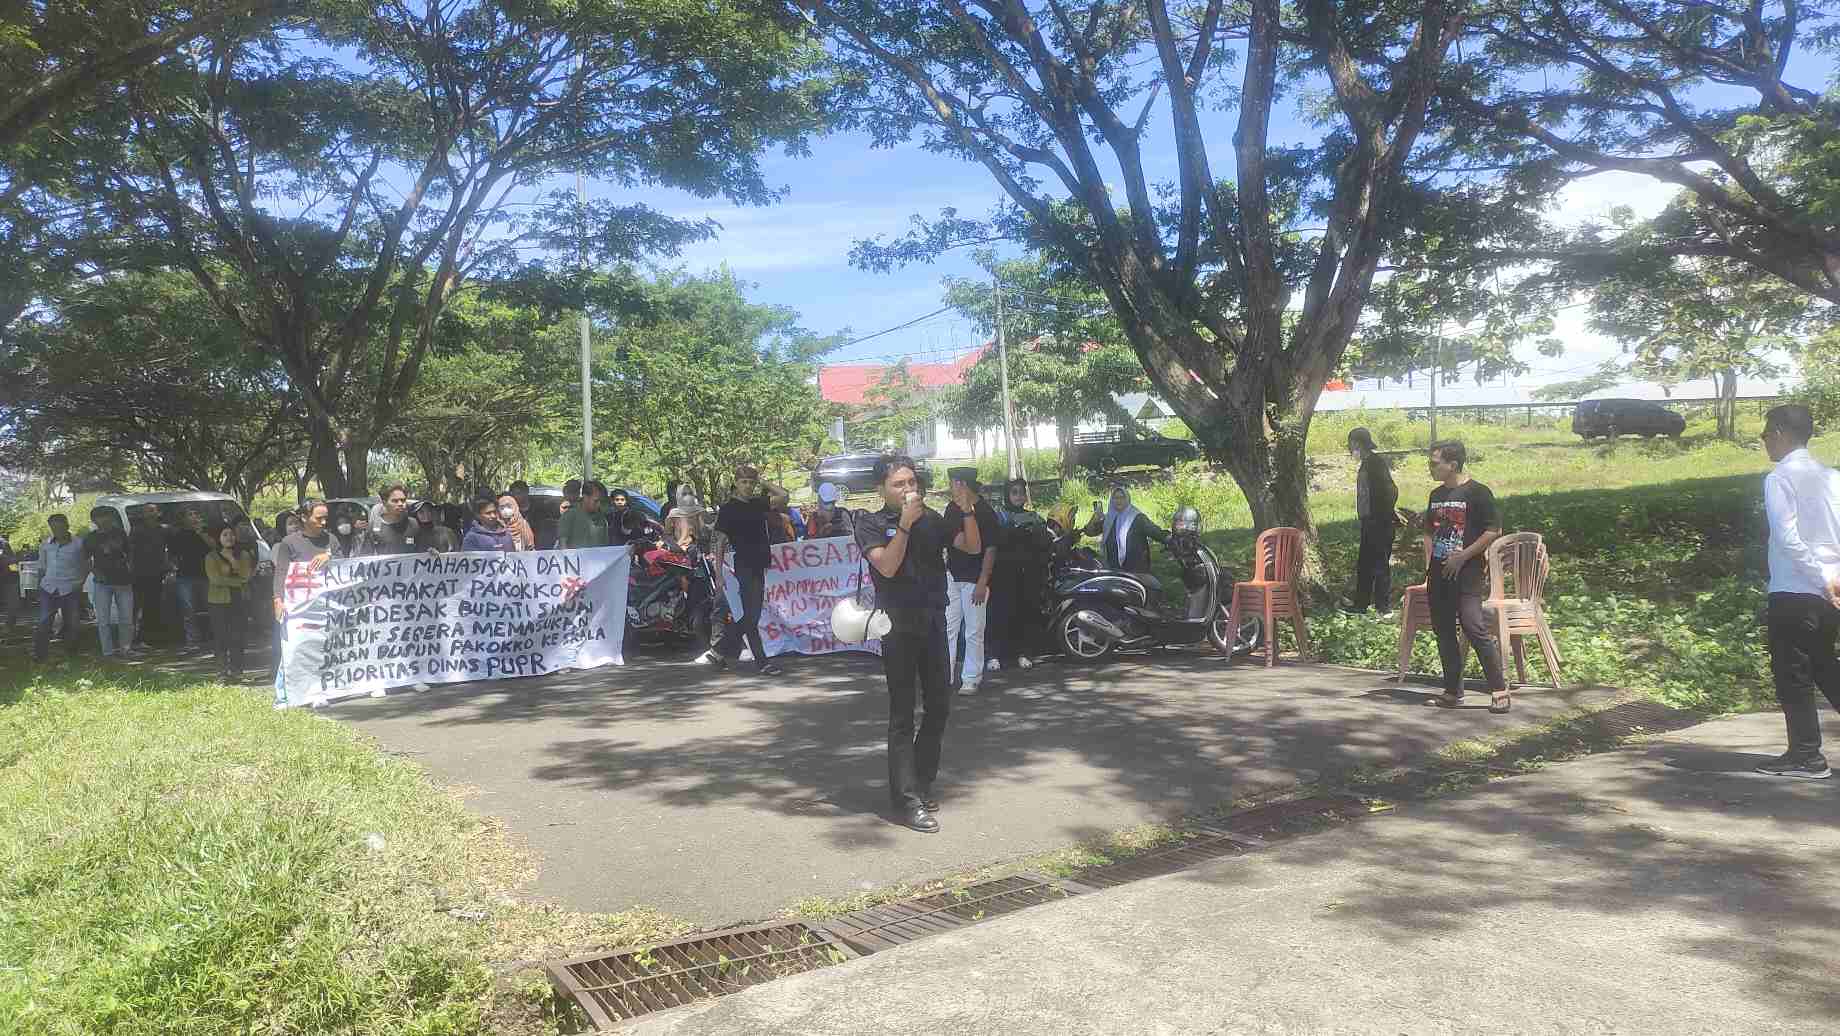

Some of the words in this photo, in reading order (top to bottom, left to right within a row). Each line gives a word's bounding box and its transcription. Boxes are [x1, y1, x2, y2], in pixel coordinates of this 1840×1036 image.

[324, 560, 402, 586] ALIANSI
[413, 556, 528, 578] MAHASISWA
[537, 555, 581, 576] DAN
[325, 578, 459, 607] MASYARAKAT
[470, 579, 563, 600] PAKOKKO
[325, 600, 447, 632] MENDESAK
[459, 600, 530, 618] BUPATI
[319, 646, 370, 670] JALAN
[377, 642, 441, 660] DUSUN
[450, 638, 534, 656] PAKOKKO
[541, 632, 560, 648] KE
[323, 628, 381, 653] UNTUK
[387, 622, 464, 643] SEGERA
[320, 659, 420, 691] PRIORITAS
[428, 657, 480, 676] DINAS
[487, 652, 548, 677] PUPR
